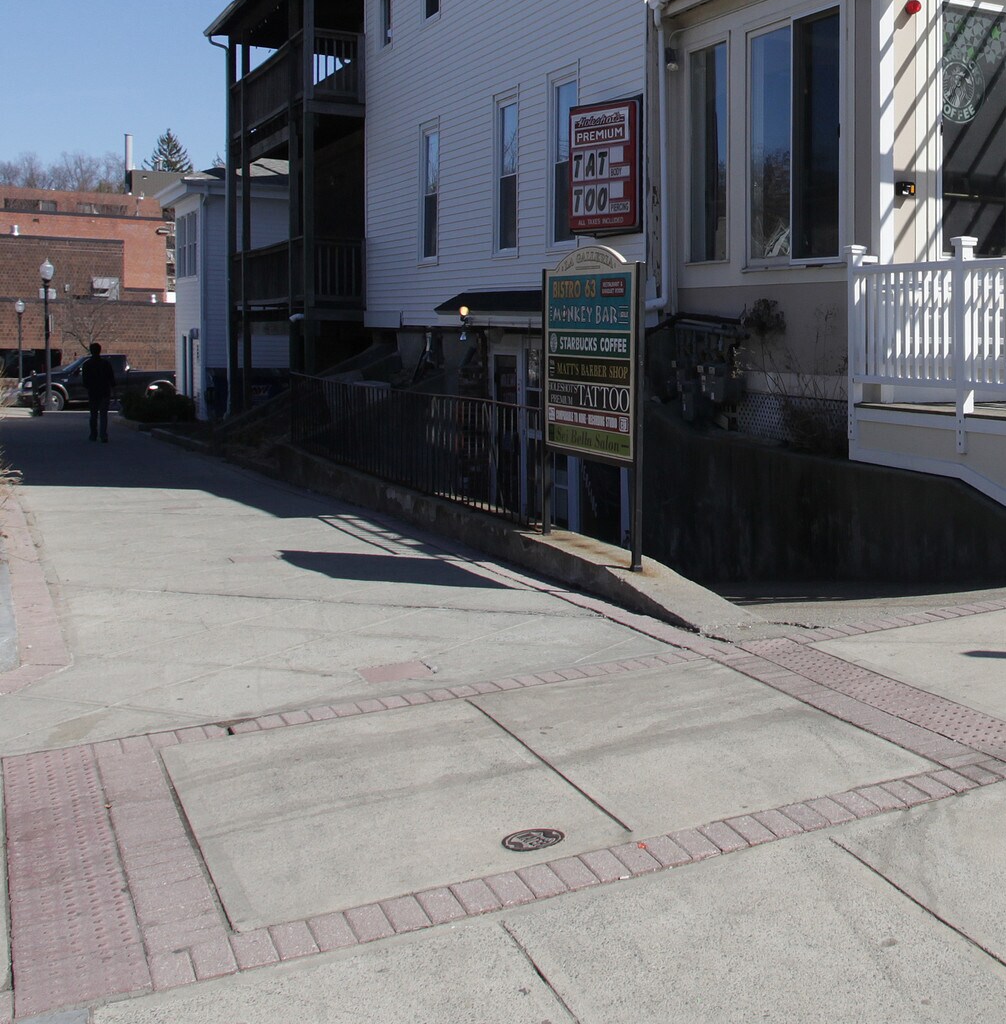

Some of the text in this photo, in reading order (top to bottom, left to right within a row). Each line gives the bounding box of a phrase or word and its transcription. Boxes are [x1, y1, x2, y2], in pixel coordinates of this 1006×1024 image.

[576, 127, 623, 143] PREMIUM
[574, 151, 608, 178] TAT
[610, 167, 622, 177] BODY
[574, 187, 608, 213] TOO
[553, 279, 596, 299] BISTRO 63
[595, 305, 618, 324] BAR
[560, 337, 627, 353] STARBUCKS COFFEE
[556, 362, 579, 375] MATT'S
[581, 364, 607, 378] BARBER
[608, 365, 629, 380] SHOP
[577, 384, 630, 412] TATTOO
[594, 434, 619, 453] Salon
